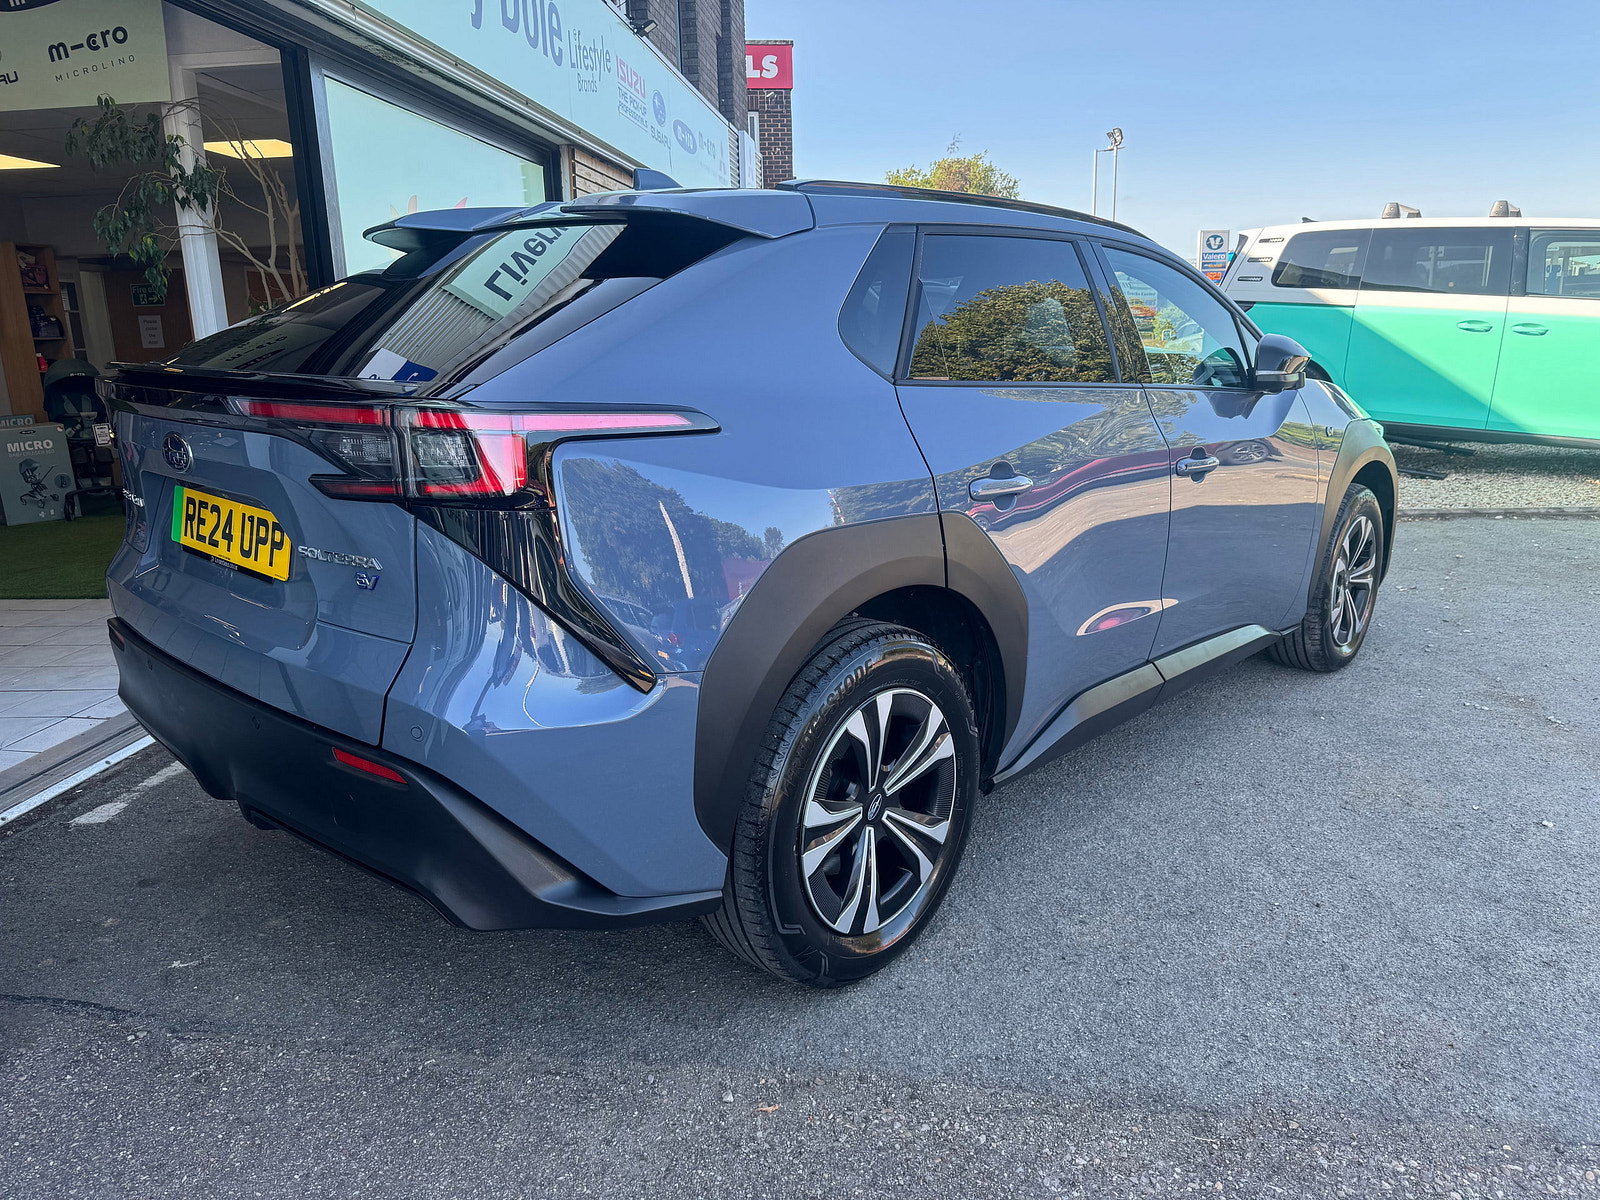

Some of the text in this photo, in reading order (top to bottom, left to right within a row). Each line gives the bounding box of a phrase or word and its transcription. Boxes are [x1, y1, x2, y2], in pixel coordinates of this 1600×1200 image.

[55, 54, 135, 82] MICROLINO
[567, 28, 612, 82] Lifestyle
[745, 54, 779, 79] LS
[576, 72, 598, 93] Brands
[615, 55, 646, 99] ISUZU
[650, 124, 672, 151] SUBARU
[132, 286, 147, 294] Fire
[0, 417, 33, 428] MICRO
[6, 439, 53, 452] MICRO
[184, 496, 285, 568] RE24 UPP
[298, 545, 383, 571] SOLTERRA
